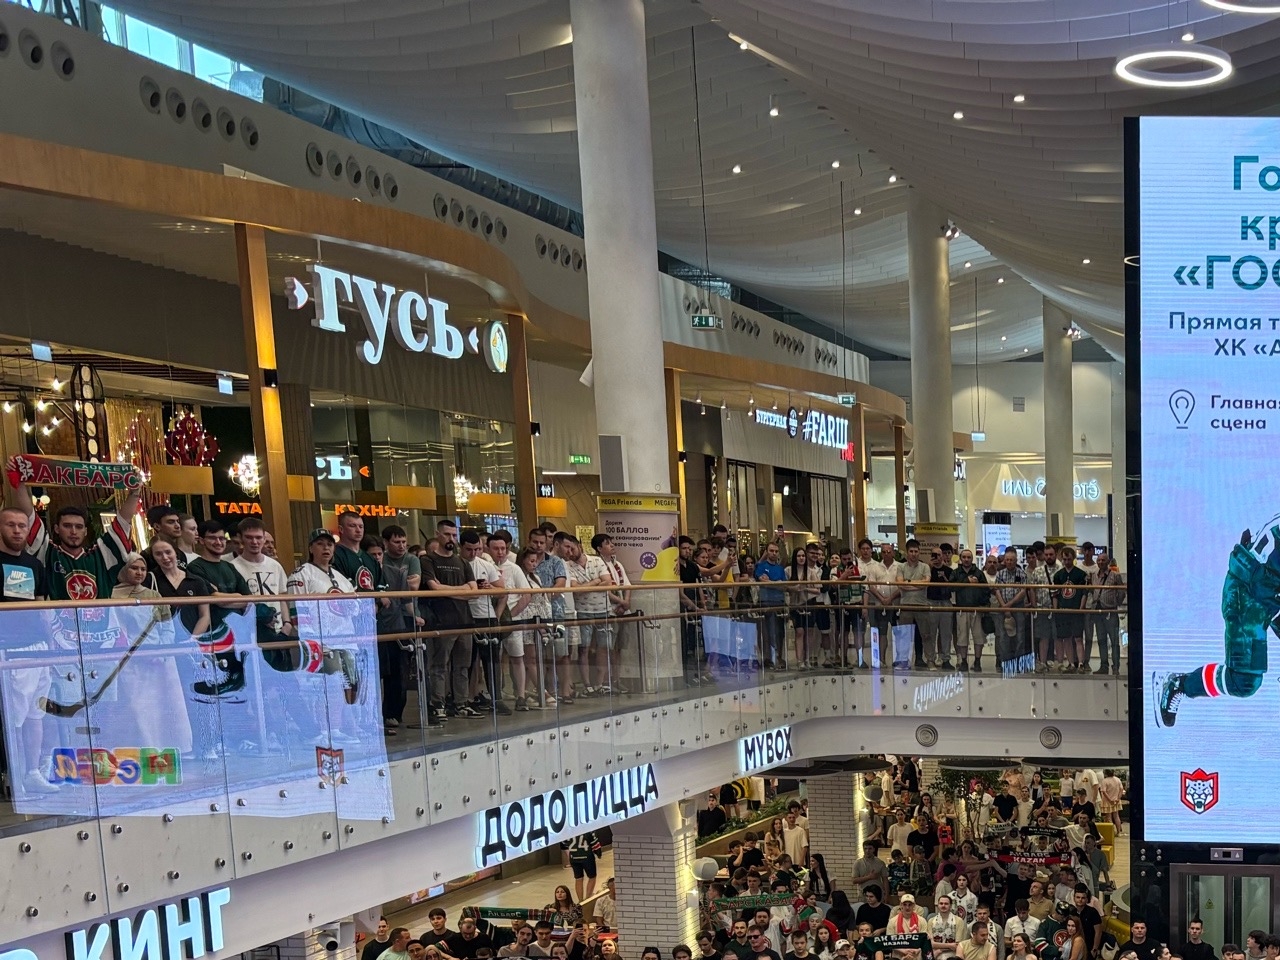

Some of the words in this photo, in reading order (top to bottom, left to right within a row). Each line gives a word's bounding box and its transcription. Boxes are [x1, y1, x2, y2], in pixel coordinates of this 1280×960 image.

[1168, 311, 1262, 335] Прямая
[1214, 339, 1246, 357] ХК
[1210, 416, 1267, 432] сцена
[9, 570, 28, 581] NIKE
[744, 726, 793, 772] MYBOX
[481, 793, 568, 867] ДОДО
[574, 763, 659, 835] ПИЦЦА
[873, 935, 891, 944] АК
[894, 933, 920, 942] БАРС
